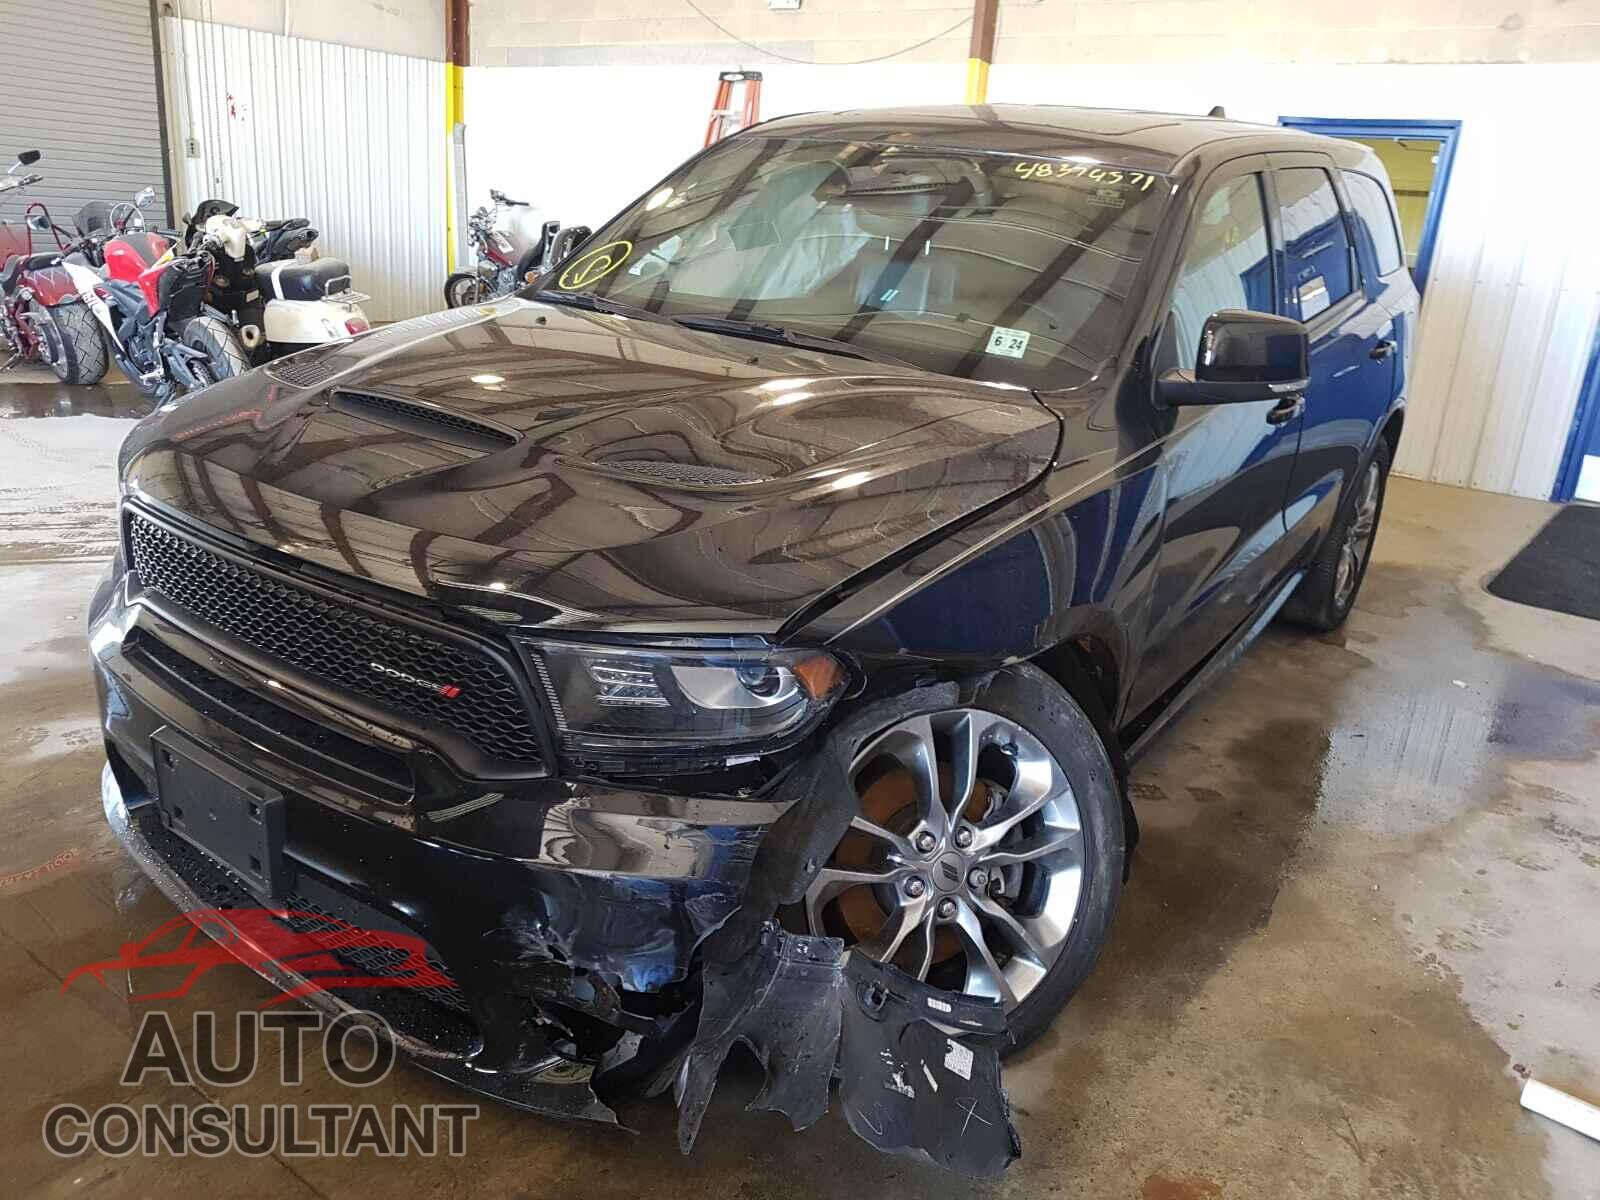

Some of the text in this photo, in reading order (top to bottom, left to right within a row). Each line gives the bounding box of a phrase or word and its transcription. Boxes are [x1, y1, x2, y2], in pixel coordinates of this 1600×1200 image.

[994, 336, 1023, 350] 6 24
[370, 662, 446, 694] DODGE
